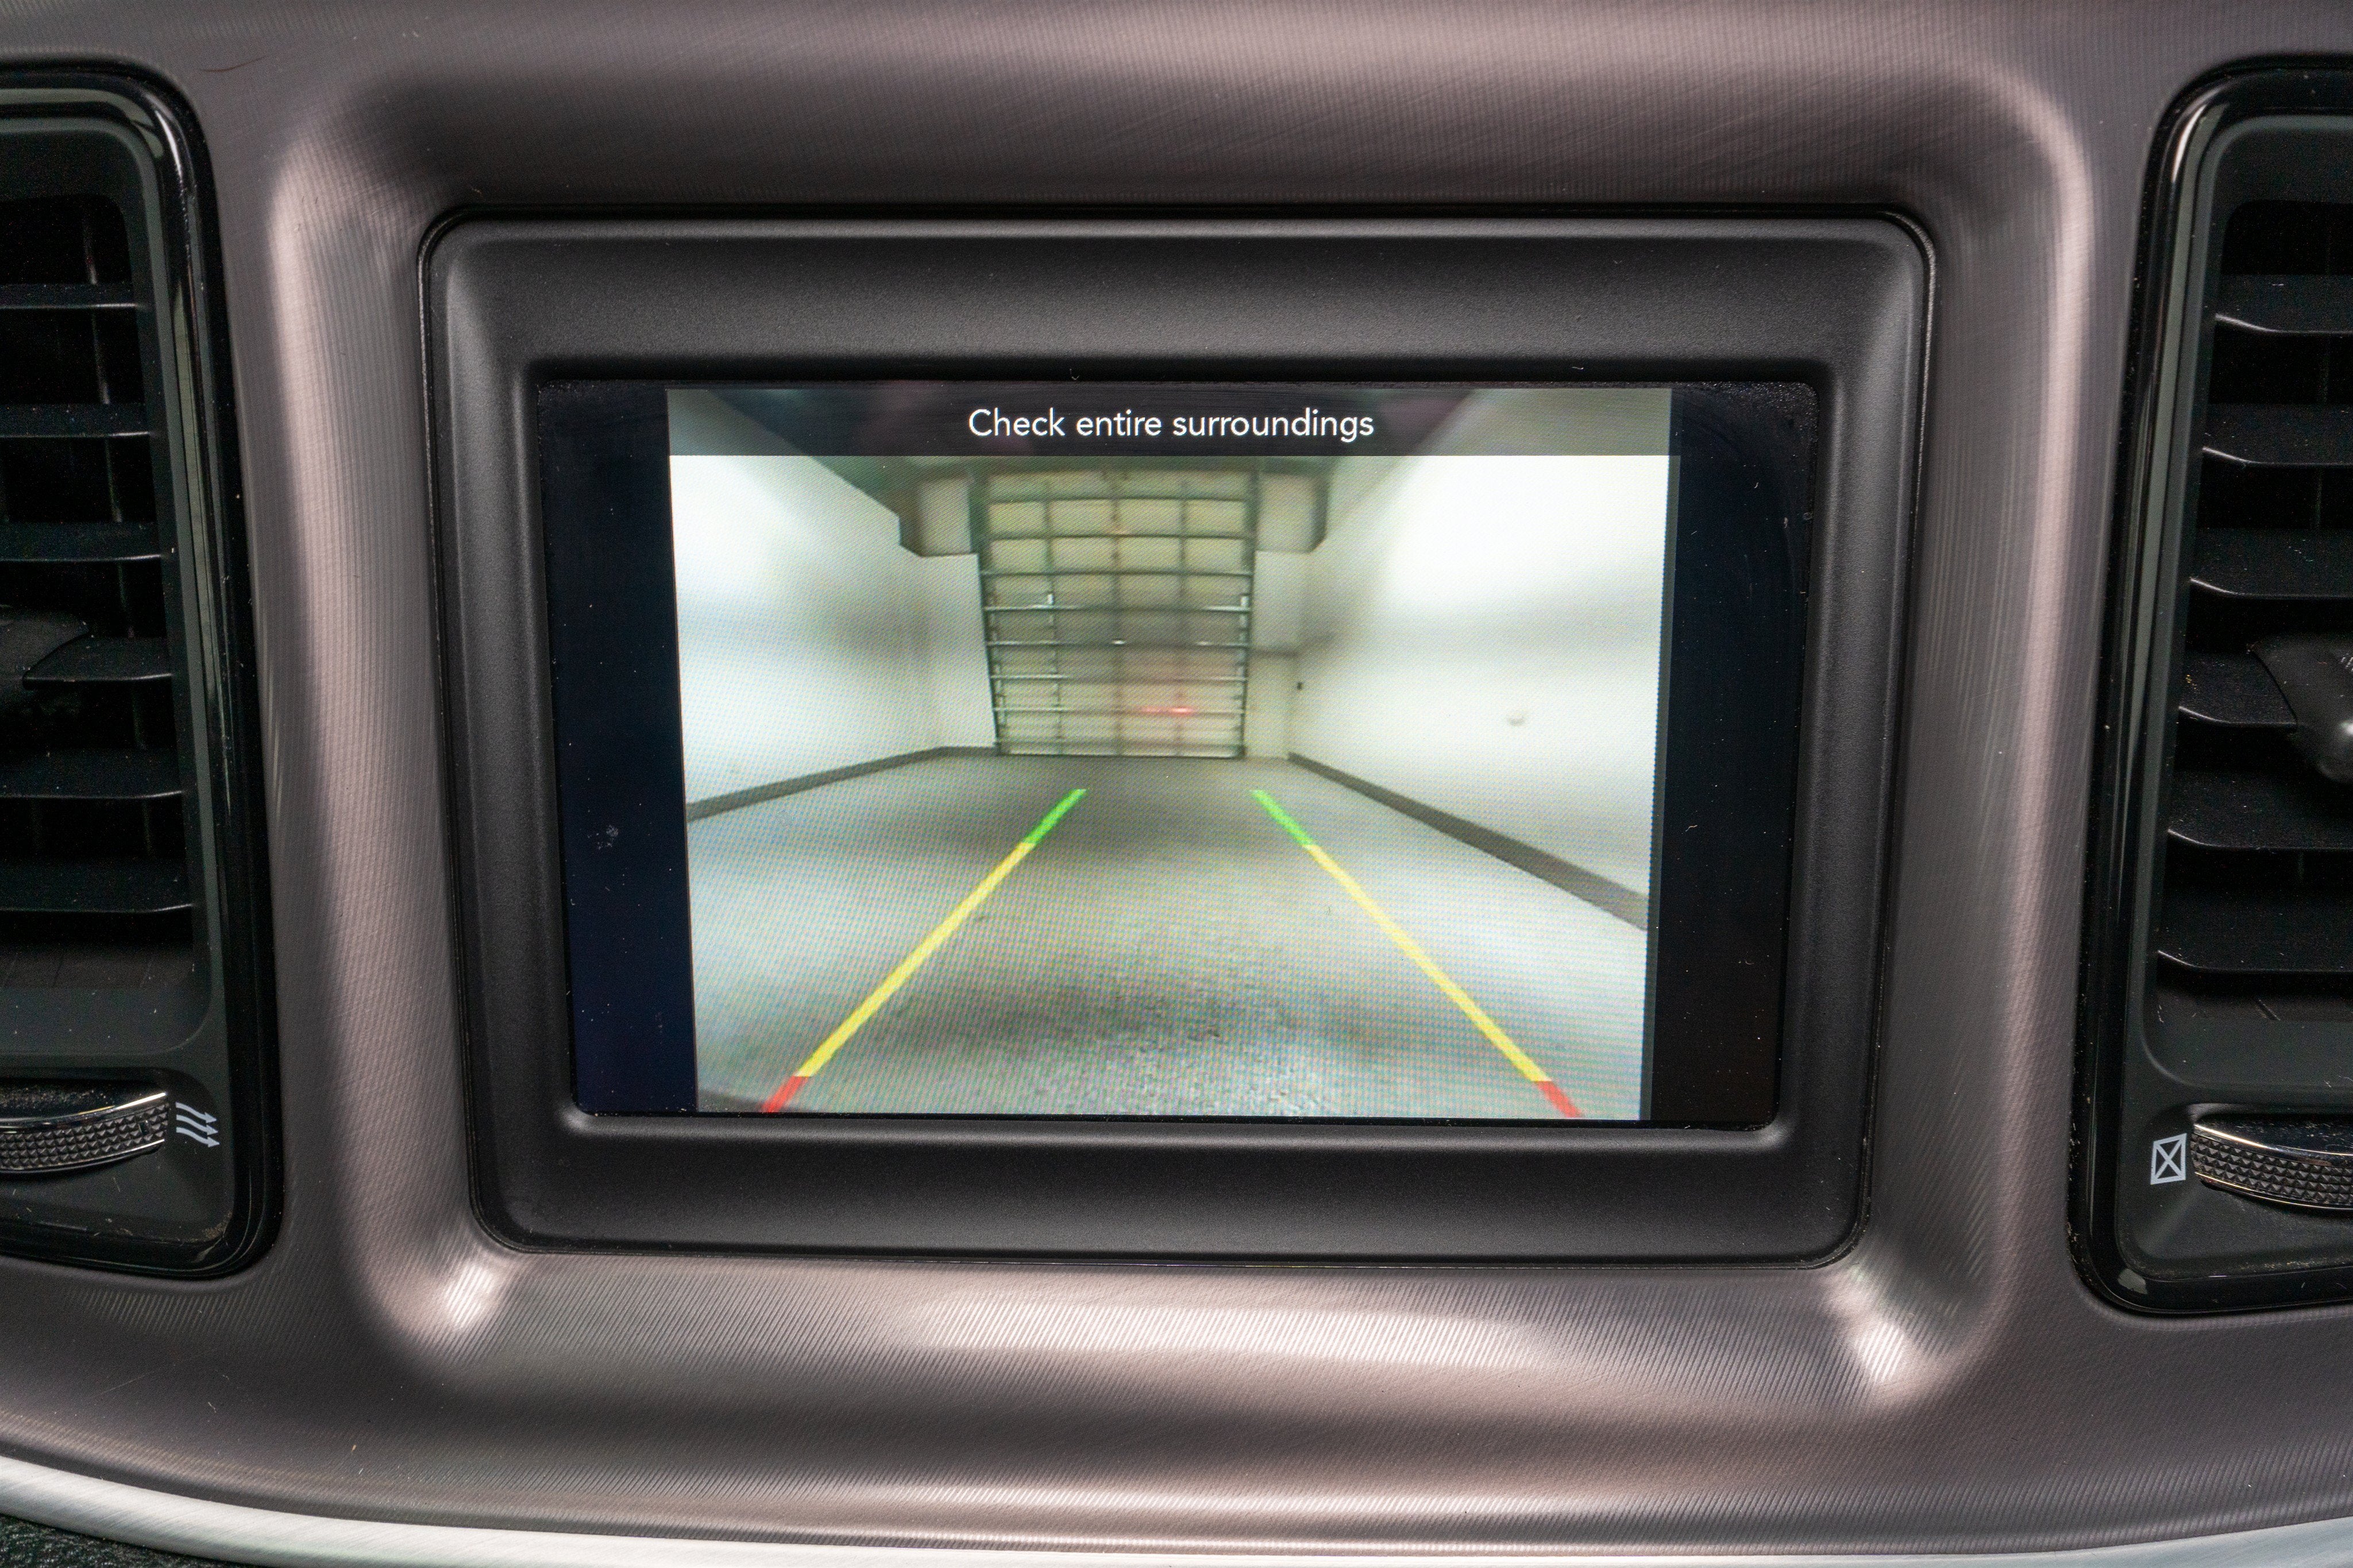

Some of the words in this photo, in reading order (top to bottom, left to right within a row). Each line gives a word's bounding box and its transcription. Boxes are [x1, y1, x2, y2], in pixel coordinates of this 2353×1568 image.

[968, 407, 1066, 437] Check
[1076, 409, 1162, 437] entire
[1172, 407, 1375, 443] surroundings
